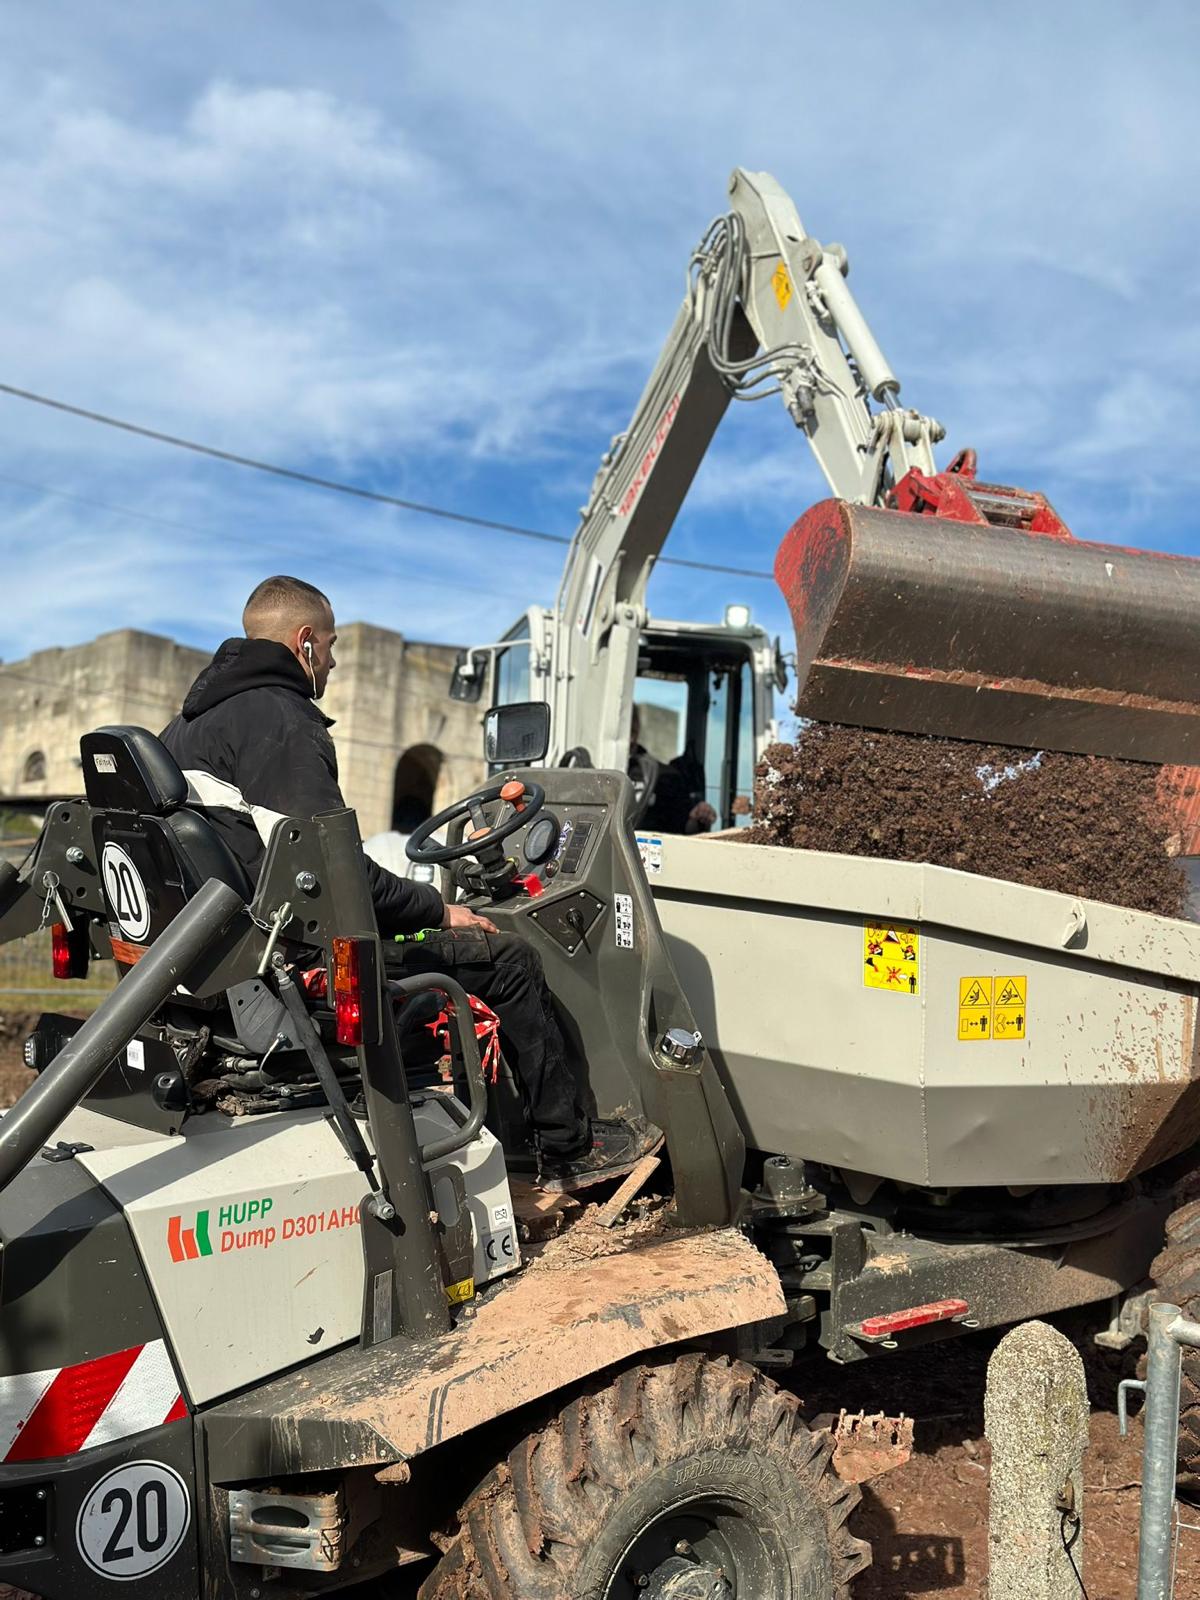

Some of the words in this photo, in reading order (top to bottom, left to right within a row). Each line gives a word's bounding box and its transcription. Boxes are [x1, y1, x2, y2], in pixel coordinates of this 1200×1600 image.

[108, 861, 143, 923] 20
[218, 1197, 273, 1228] HUPP
[221, 1226, 276, 1252] Dump
[486, 1234, 513, 1261] CE
[101, 1480, 168, 1563] 20
